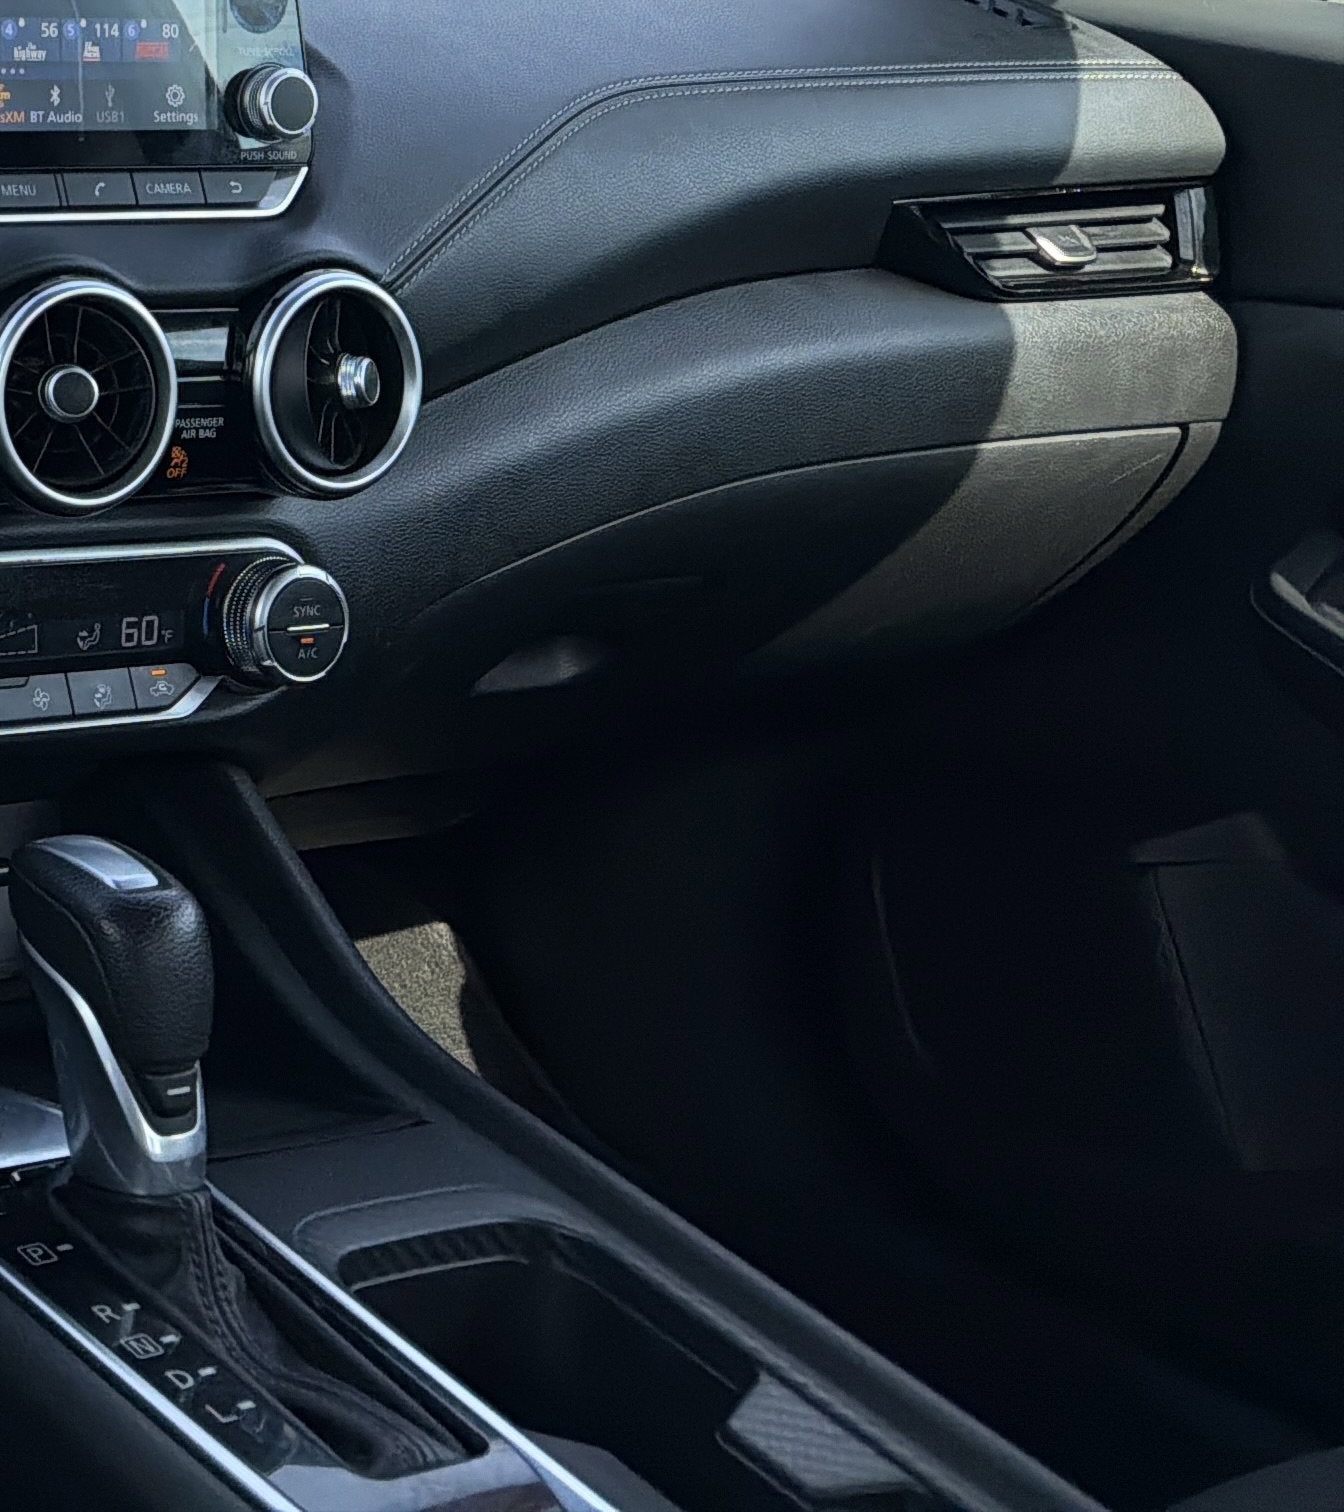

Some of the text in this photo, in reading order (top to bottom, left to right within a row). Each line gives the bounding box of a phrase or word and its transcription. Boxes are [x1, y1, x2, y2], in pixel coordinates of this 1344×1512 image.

[41, 22, 58, 38] 56
[94, 23, 120, 38] 114
[162, 23, 179, 38] 80
[30, 111, 83, 123] BT Audio
[96, 112, 124, 123] USB1
[153, 110, 198, 126] Settings
[240, 149, 297, 162] PUSH SOUND
[0, 185, 36, 198] MENU
[145, 183, 192, 195] CAMERA
[175, 416, 224, 428] PASSENGER
[180, 428, 217, 439] AIR BAG
[166, 467, 188, 479] OFF
[293, 604, 321, 617] SYNC
[297, 647, 318, 659] A/C
[91, 1304, 121, 1324] R
[165, 1369, 195, 1390] D
[204, 1404, 239, 1423] L
